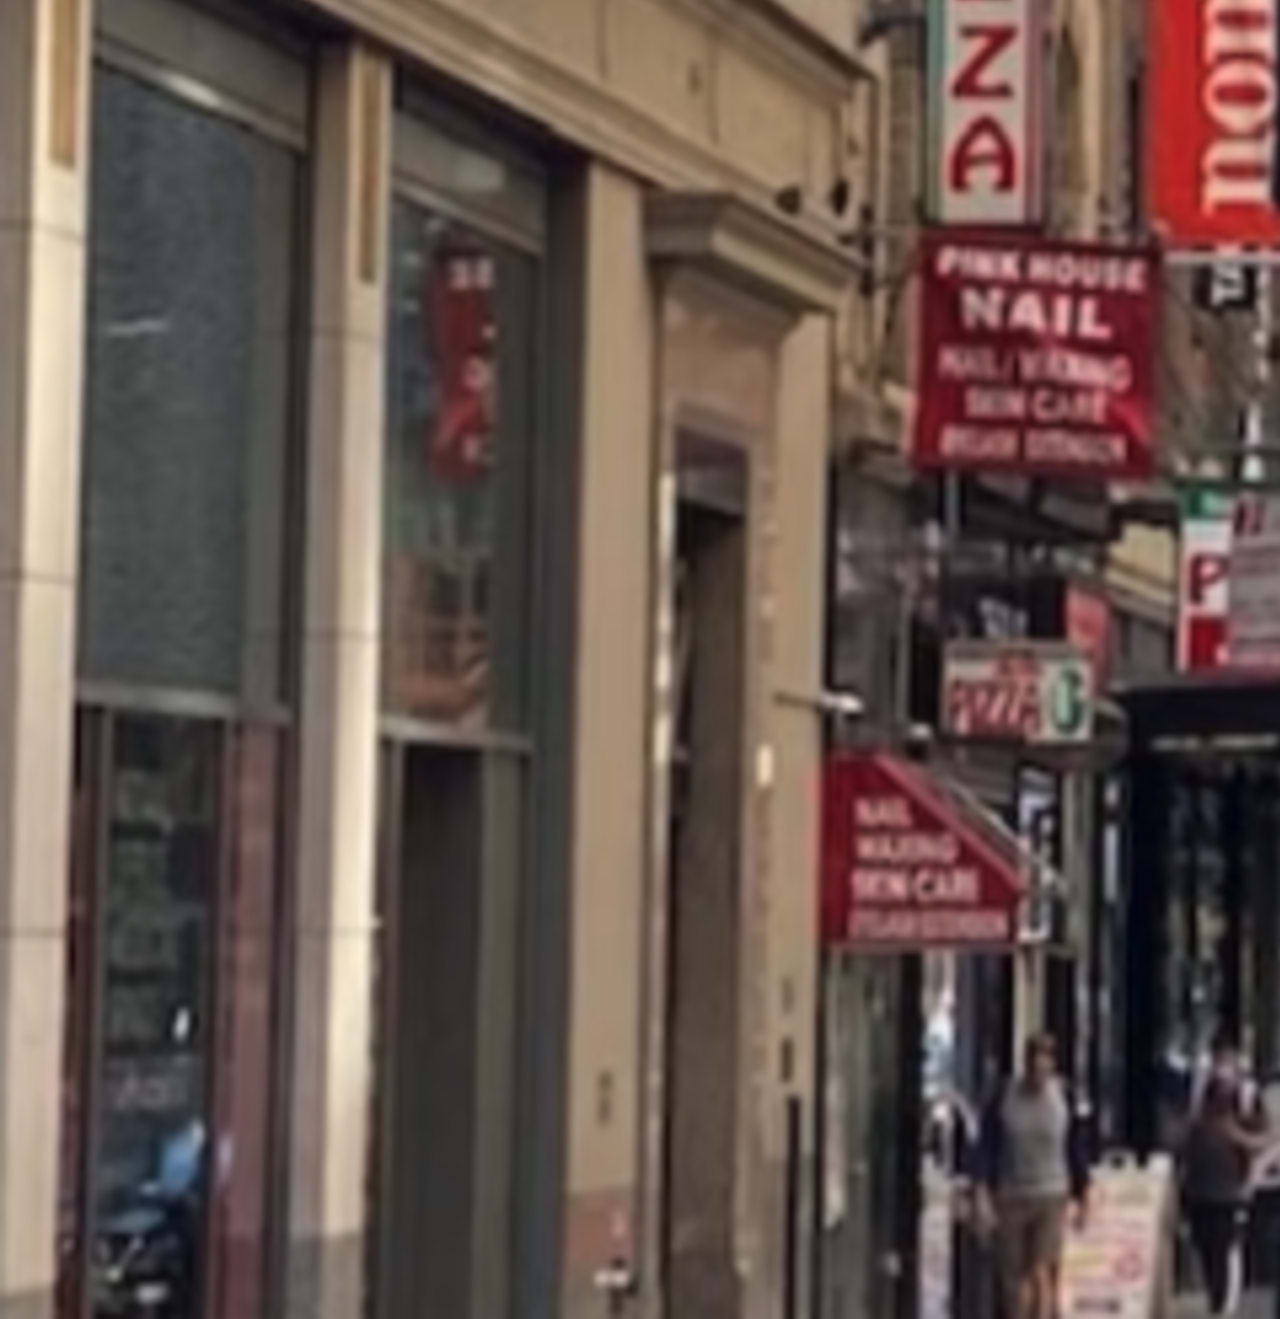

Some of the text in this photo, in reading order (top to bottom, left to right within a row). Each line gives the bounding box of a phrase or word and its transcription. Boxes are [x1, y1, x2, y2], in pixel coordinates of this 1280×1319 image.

[936, 244, 1147, 294] PINK HOUSE
[959, 285, 1114, 341] NAIL
